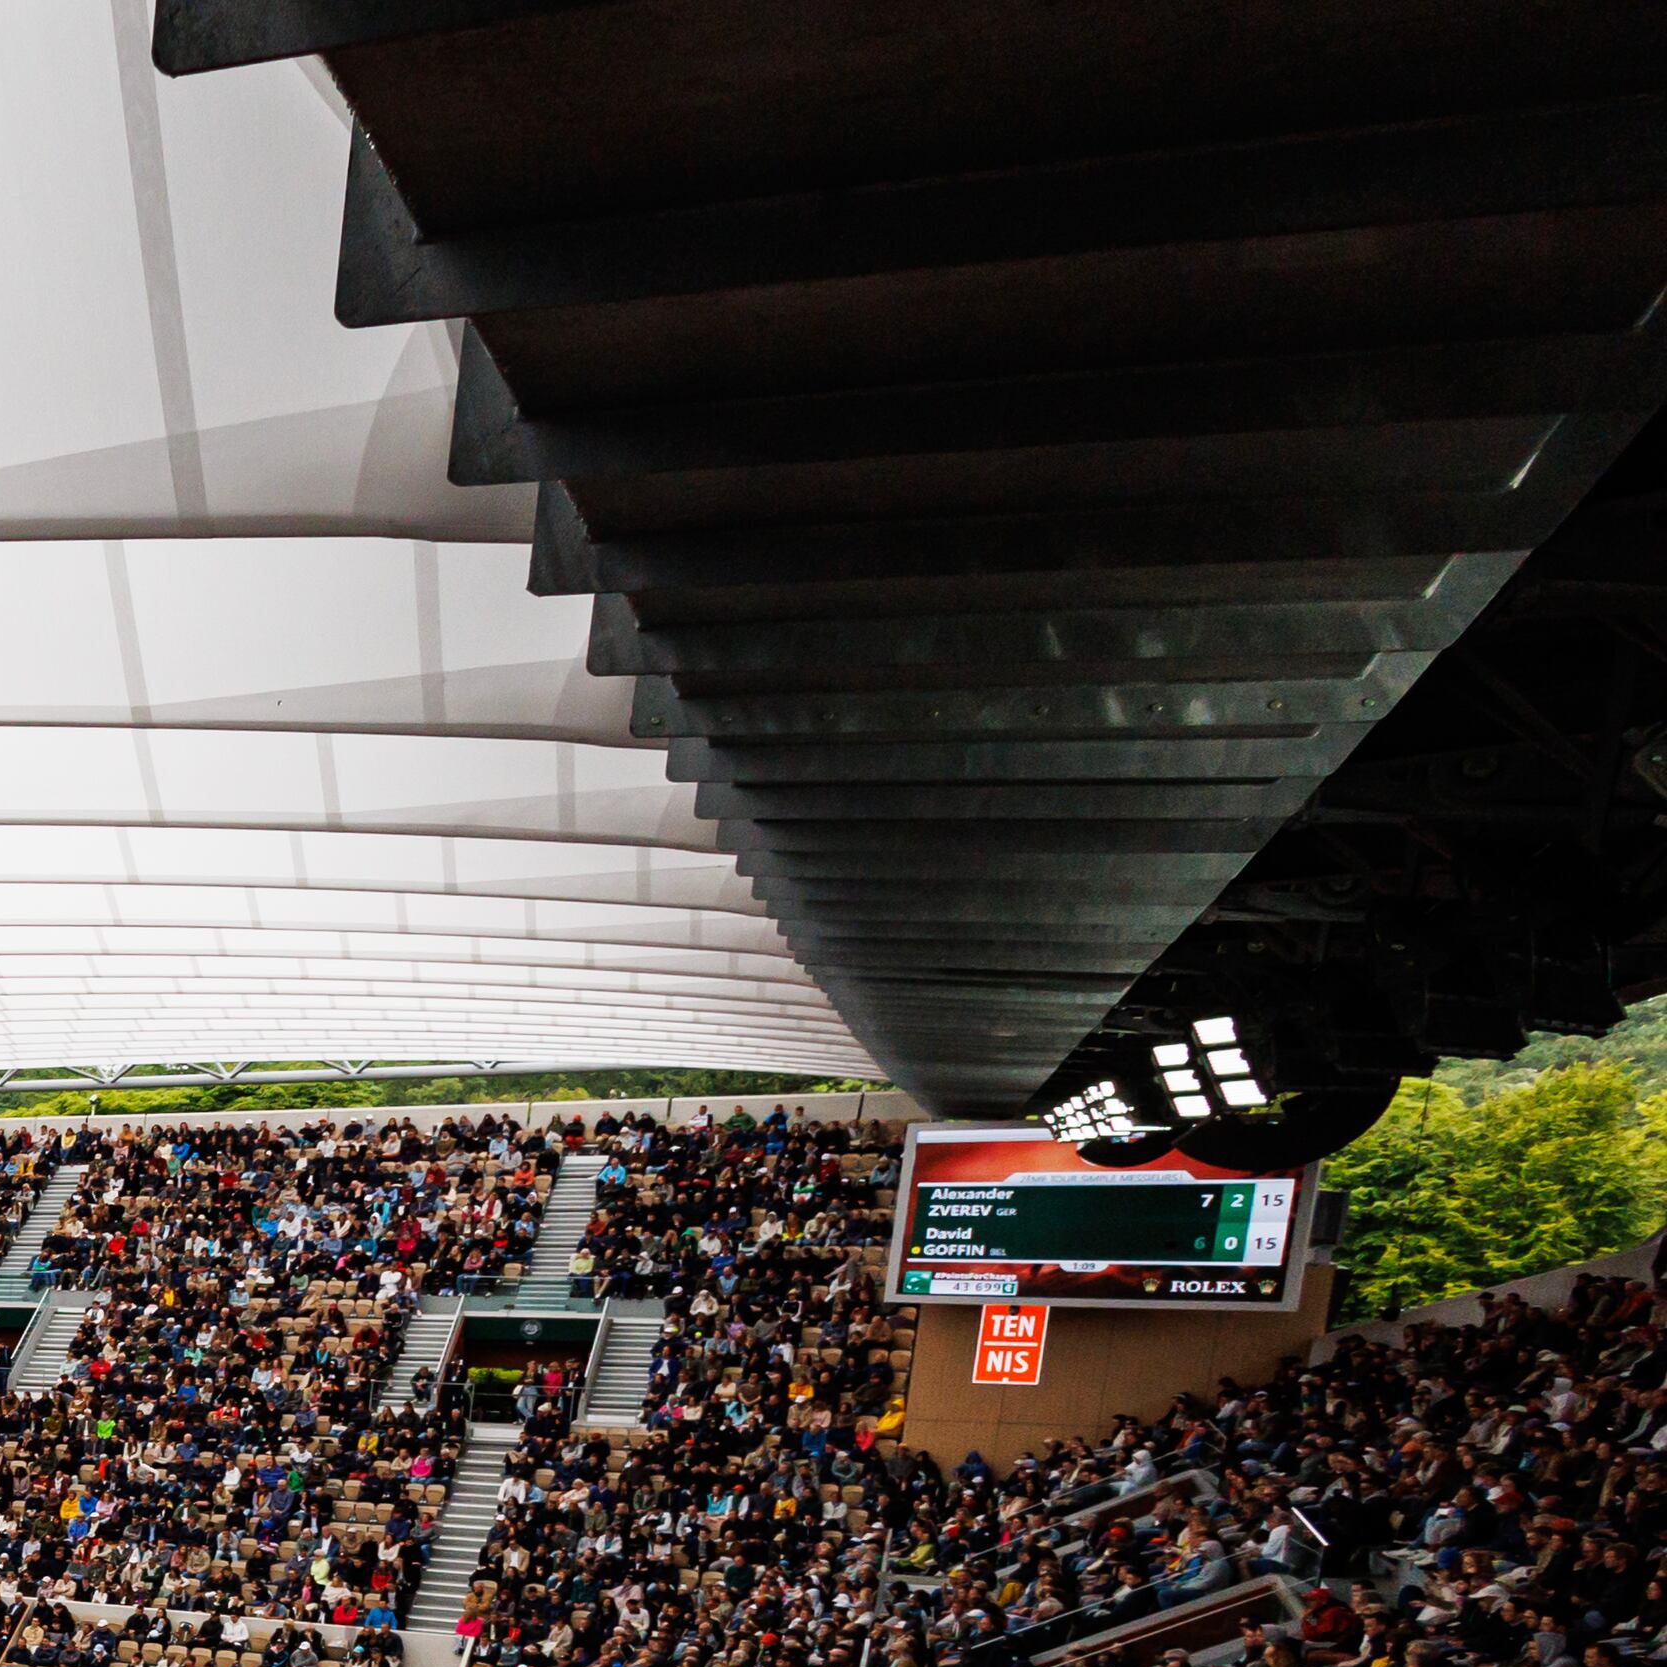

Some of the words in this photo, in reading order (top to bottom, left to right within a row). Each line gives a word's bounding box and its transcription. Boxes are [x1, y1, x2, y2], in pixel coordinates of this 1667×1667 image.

[931, 1188, 1014, 1200] Alexander
[1200, 1193, 1214, 1207] 7
[1230, 1193, 1245, 1207] 2
[1262, 1194, 1284, 1206] 15
[928, 1204, 993, 1217] ZVEREV
[926, 1227, 973, 1239] David
[923, 1244, 985, 1256] GOFFIN
[1194, 1236, 1206, 1249] 6
[1224, 1236, 1238, 1250] 0
[1255, 1237, 1277, 1249] 15
[1170, 1280, 1247, 1294] ROLEX
[991, 1315, 1036, 1337] TEN
[986, 1350, 1029, 1373] NIS
